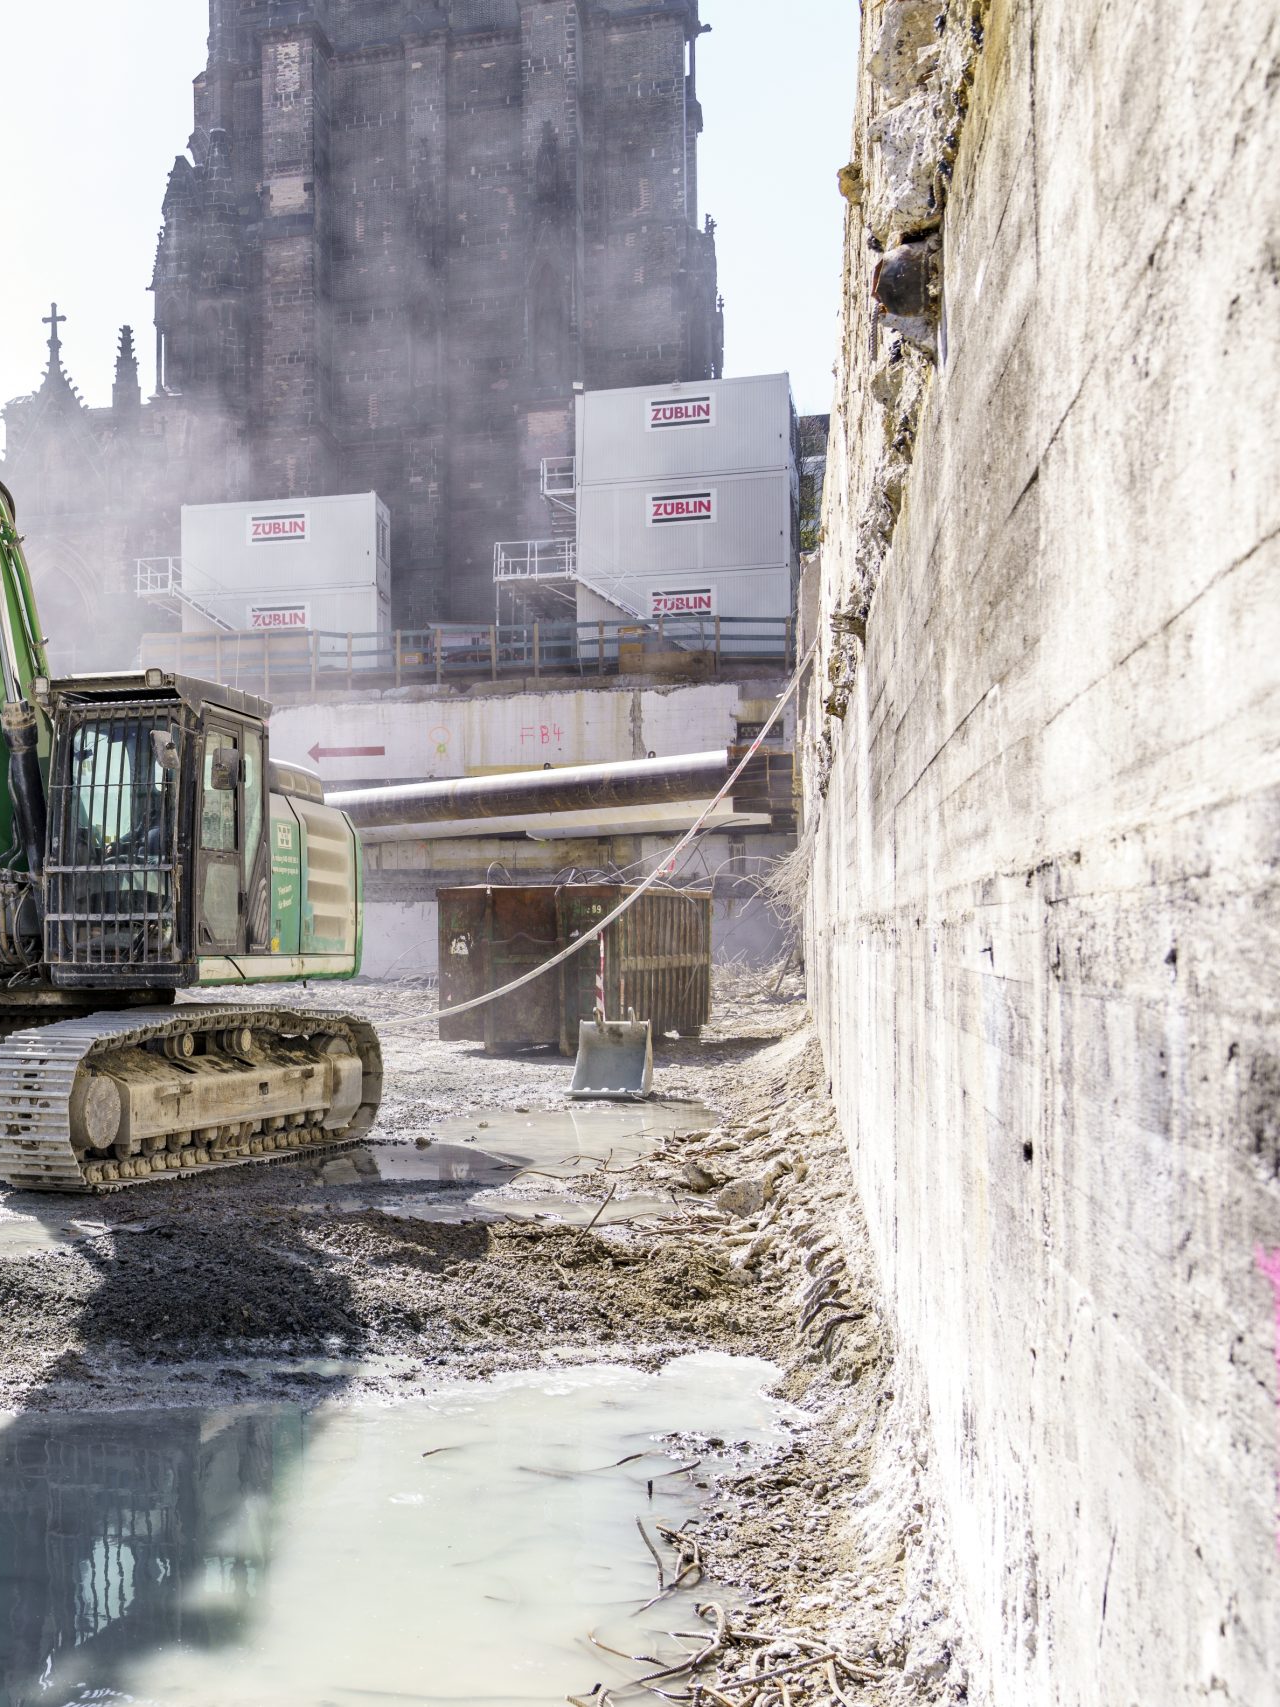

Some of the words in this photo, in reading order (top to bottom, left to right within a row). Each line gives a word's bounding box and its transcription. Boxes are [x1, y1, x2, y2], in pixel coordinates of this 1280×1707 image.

[651, 403, 710, 422] ZÜBLIN
[652, 499, 711, 517] ZÜBLIN
[251, 520, 306, 536] ZÜBLIN
[652, 595, 712, 612] ZÜBLIN
[251, 612, 306, 627] ZÜBLIN
